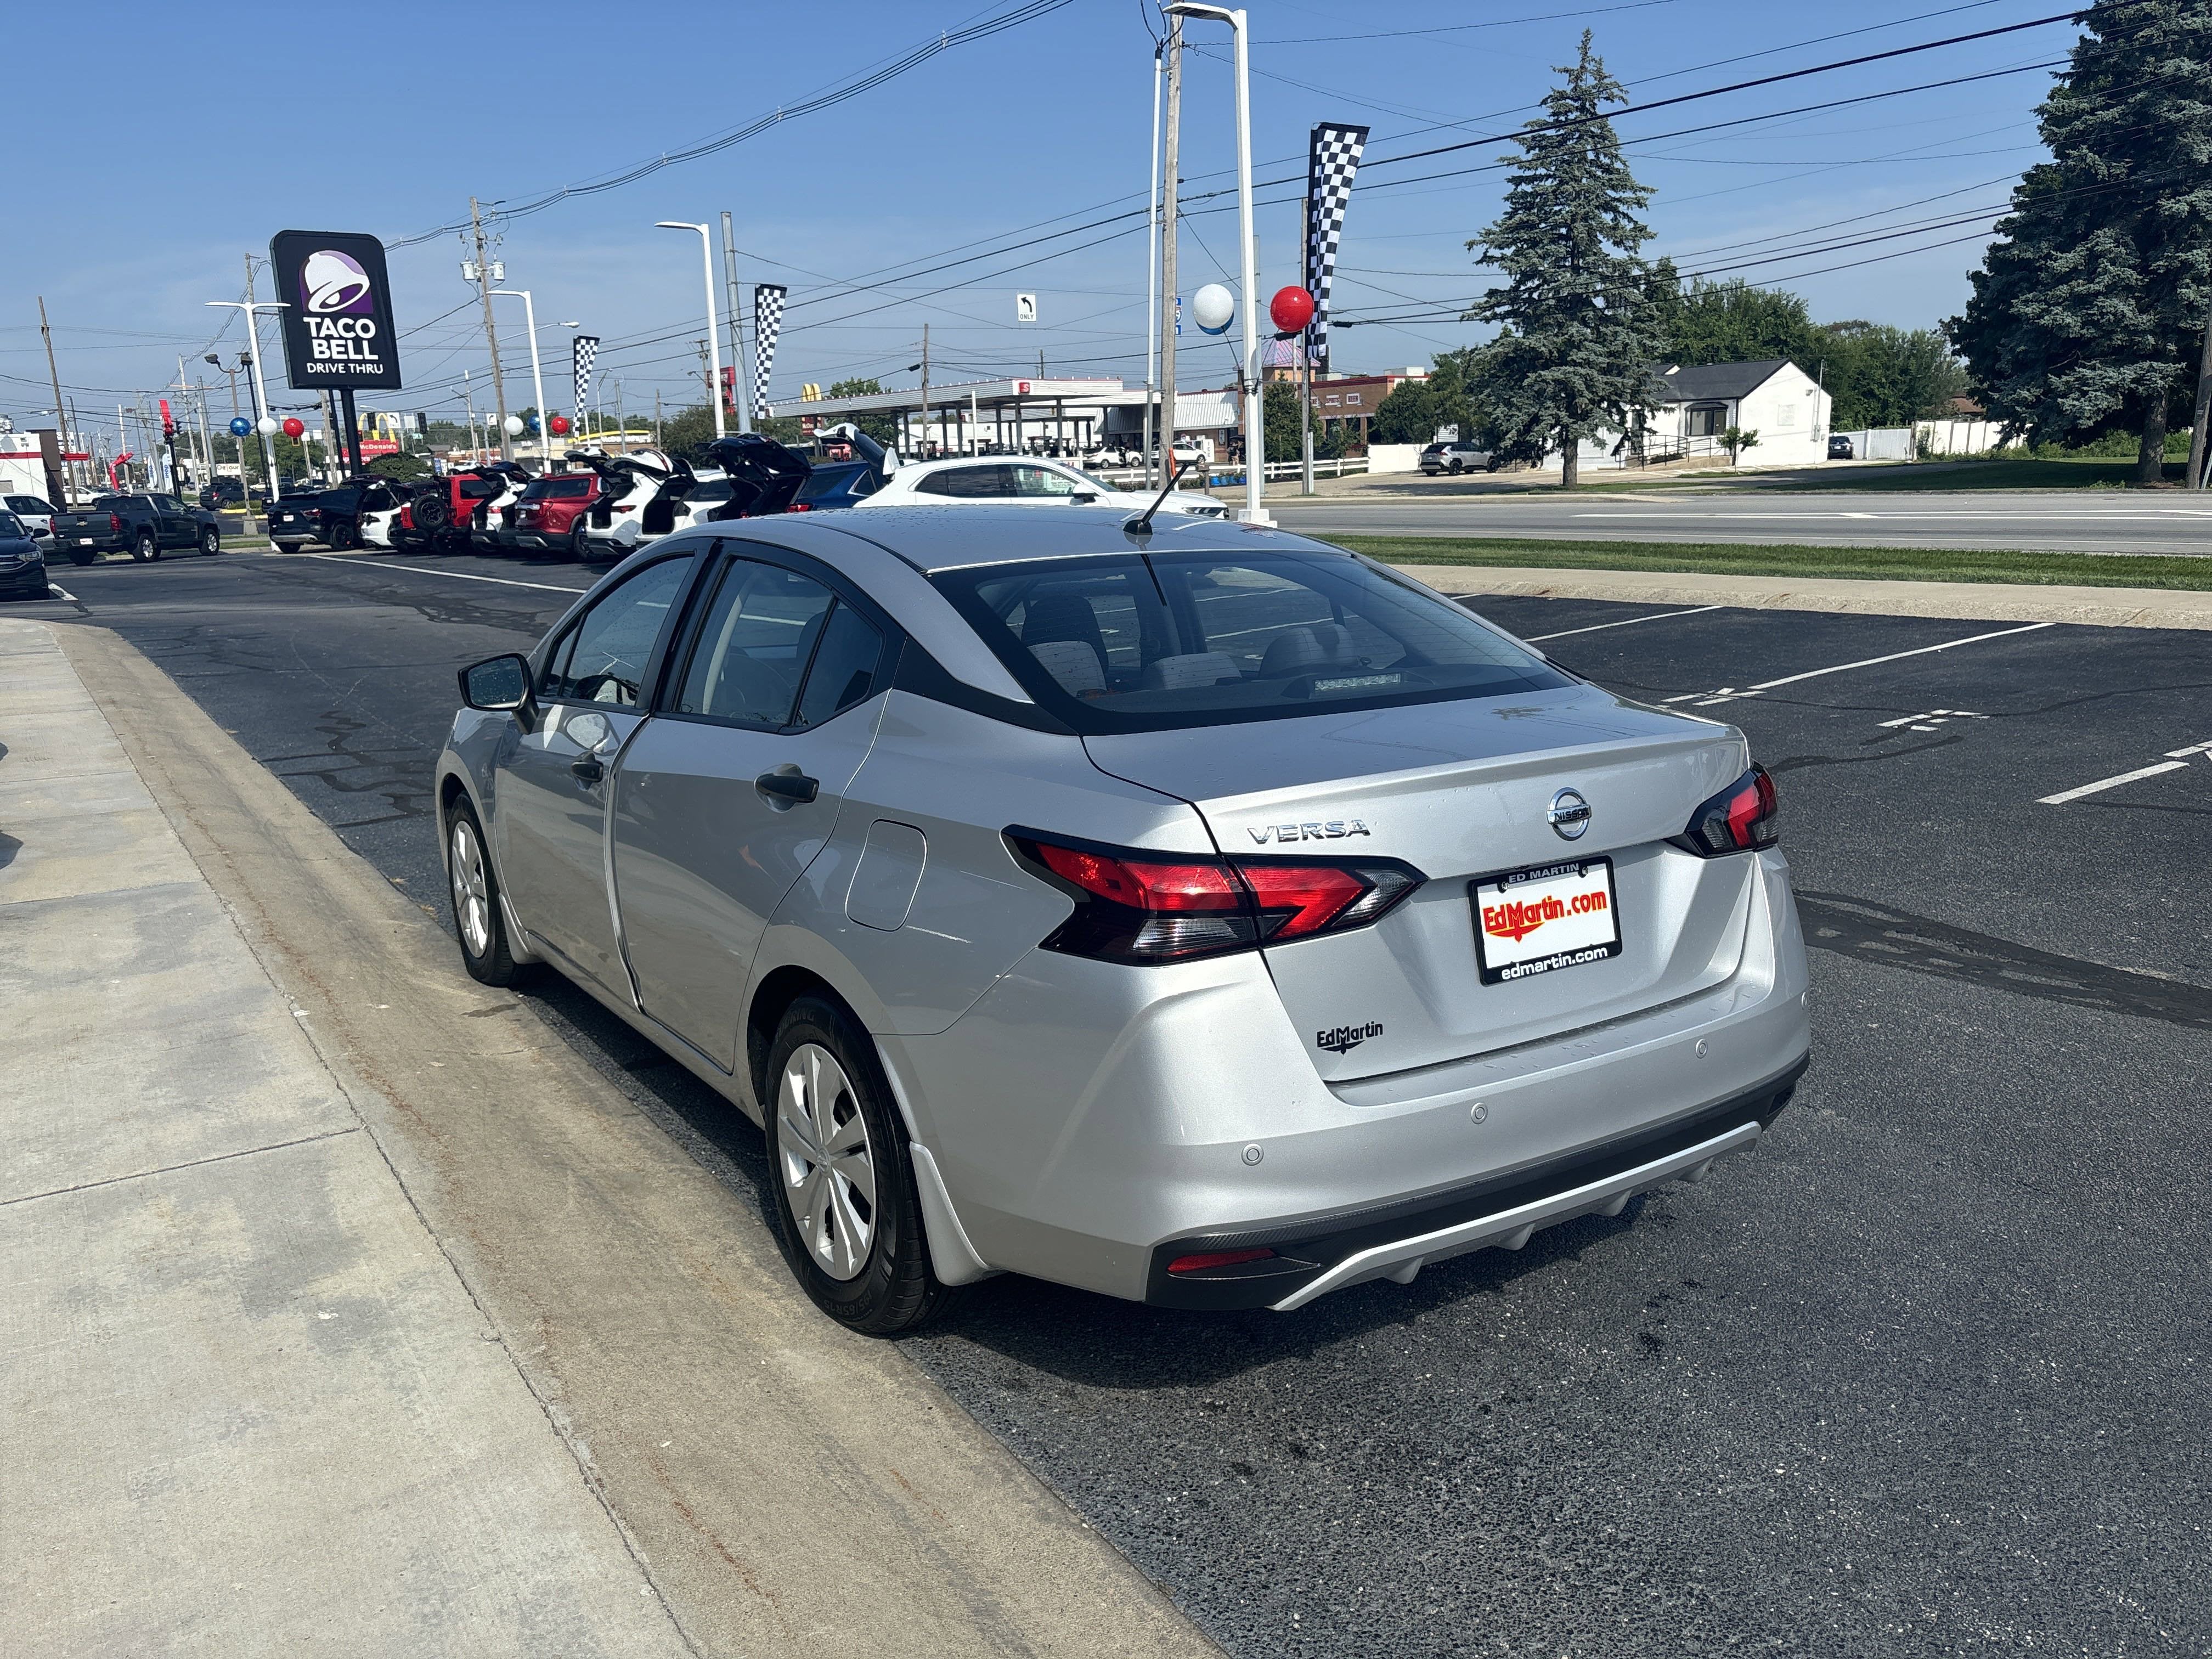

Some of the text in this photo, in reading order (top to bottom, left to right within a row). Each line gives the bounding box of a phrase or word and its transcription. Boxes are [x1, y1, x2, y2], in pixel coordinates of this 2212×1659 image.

[303, 317, 376, 338] TACO
[312, 339, 379, 360] BELL
[307, 363, 383, 374] DRIVE THRU
[1554, 807, 1590, 821] NISSAN
[1247, 819, 1370, 844] VERSA
[1509, 864, 1579, 883] ED MARTIN
[1501, 947, 1608, 980] edmartin.com
[1317, 1020, 1383, 1048] EdMartin
[823, 1288, 873, 1317] 195/65R15
